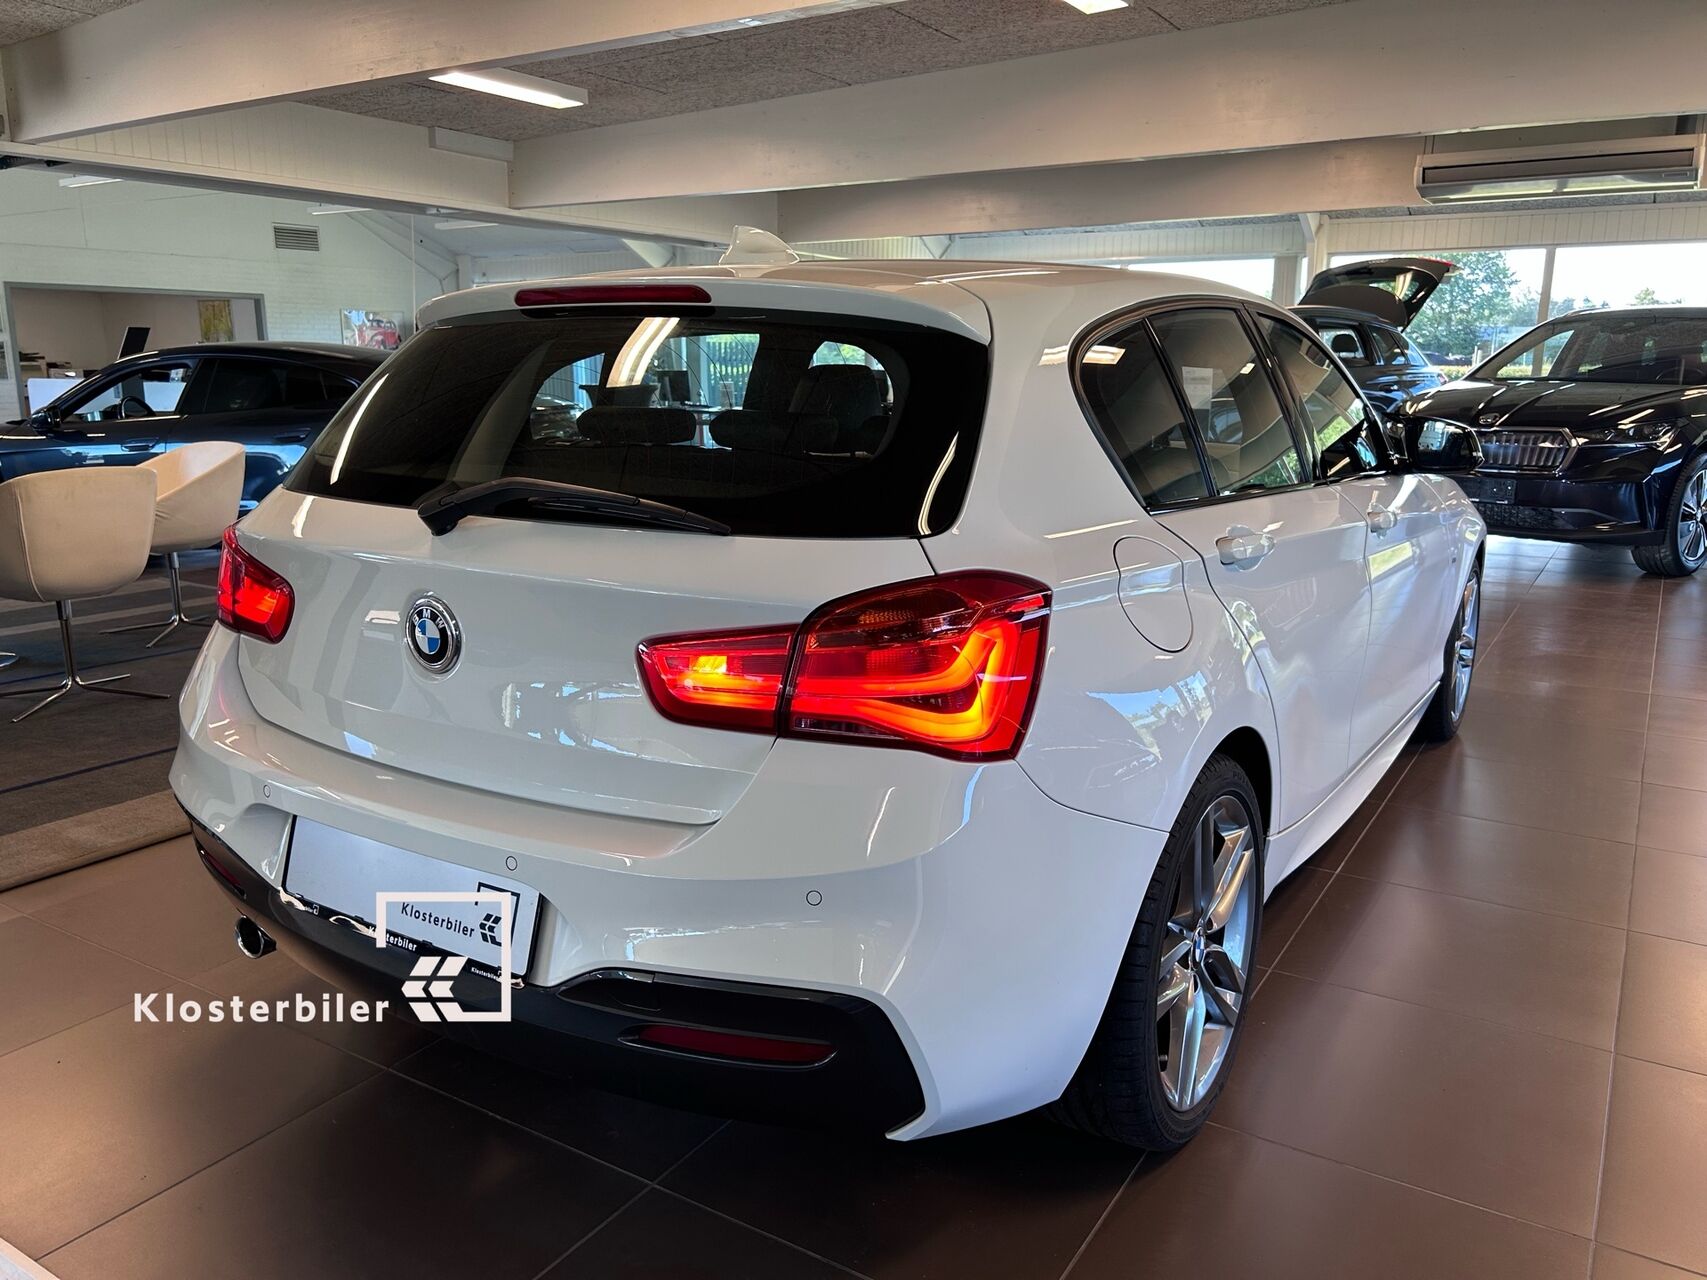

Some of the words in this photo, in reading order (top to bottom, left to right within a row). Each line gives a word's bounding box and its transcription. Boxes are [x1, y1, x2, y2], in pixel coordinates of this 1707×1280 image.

[412, 608, 445, 629] BMW
[401, 902, 475, 938] Klosterbiler
[368, 926, 417, 952] Kterbiler
